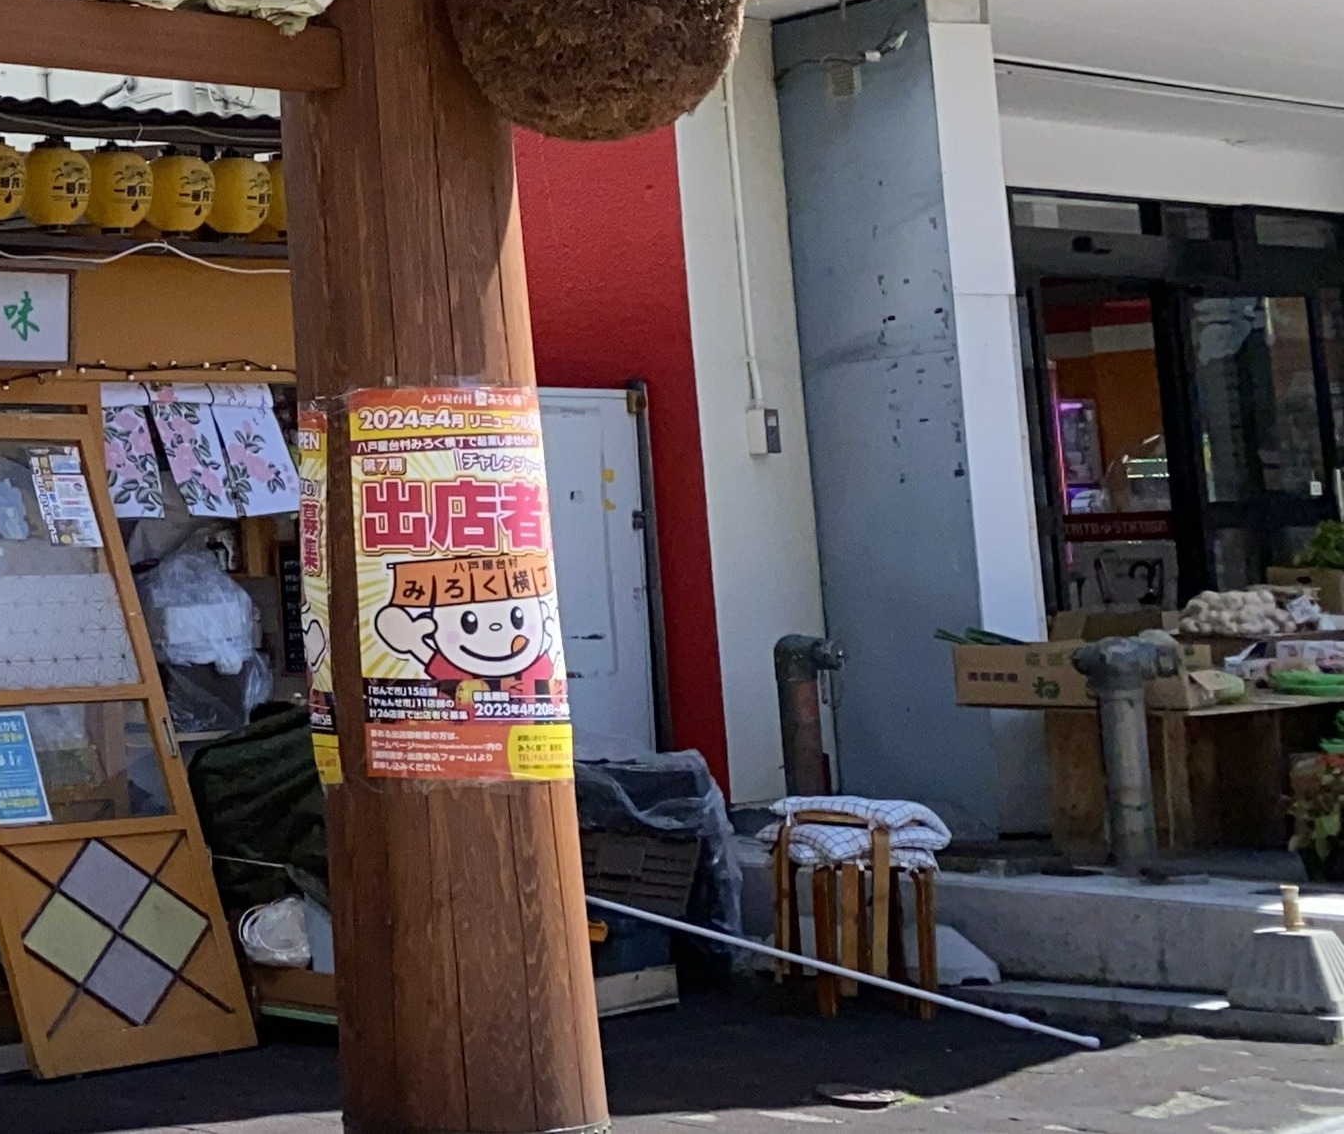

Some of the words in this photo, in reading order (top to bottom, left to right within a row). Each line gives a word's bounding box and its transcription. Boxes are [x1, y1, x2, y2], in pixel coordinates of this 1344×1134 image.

[359, 407, 465, 430] 2024年4月
[360, 478, 547, 551] 出店者
[452, 556, 519, 574] 八戸屋台村
[402, 565, 549, 599] みろく横丁
